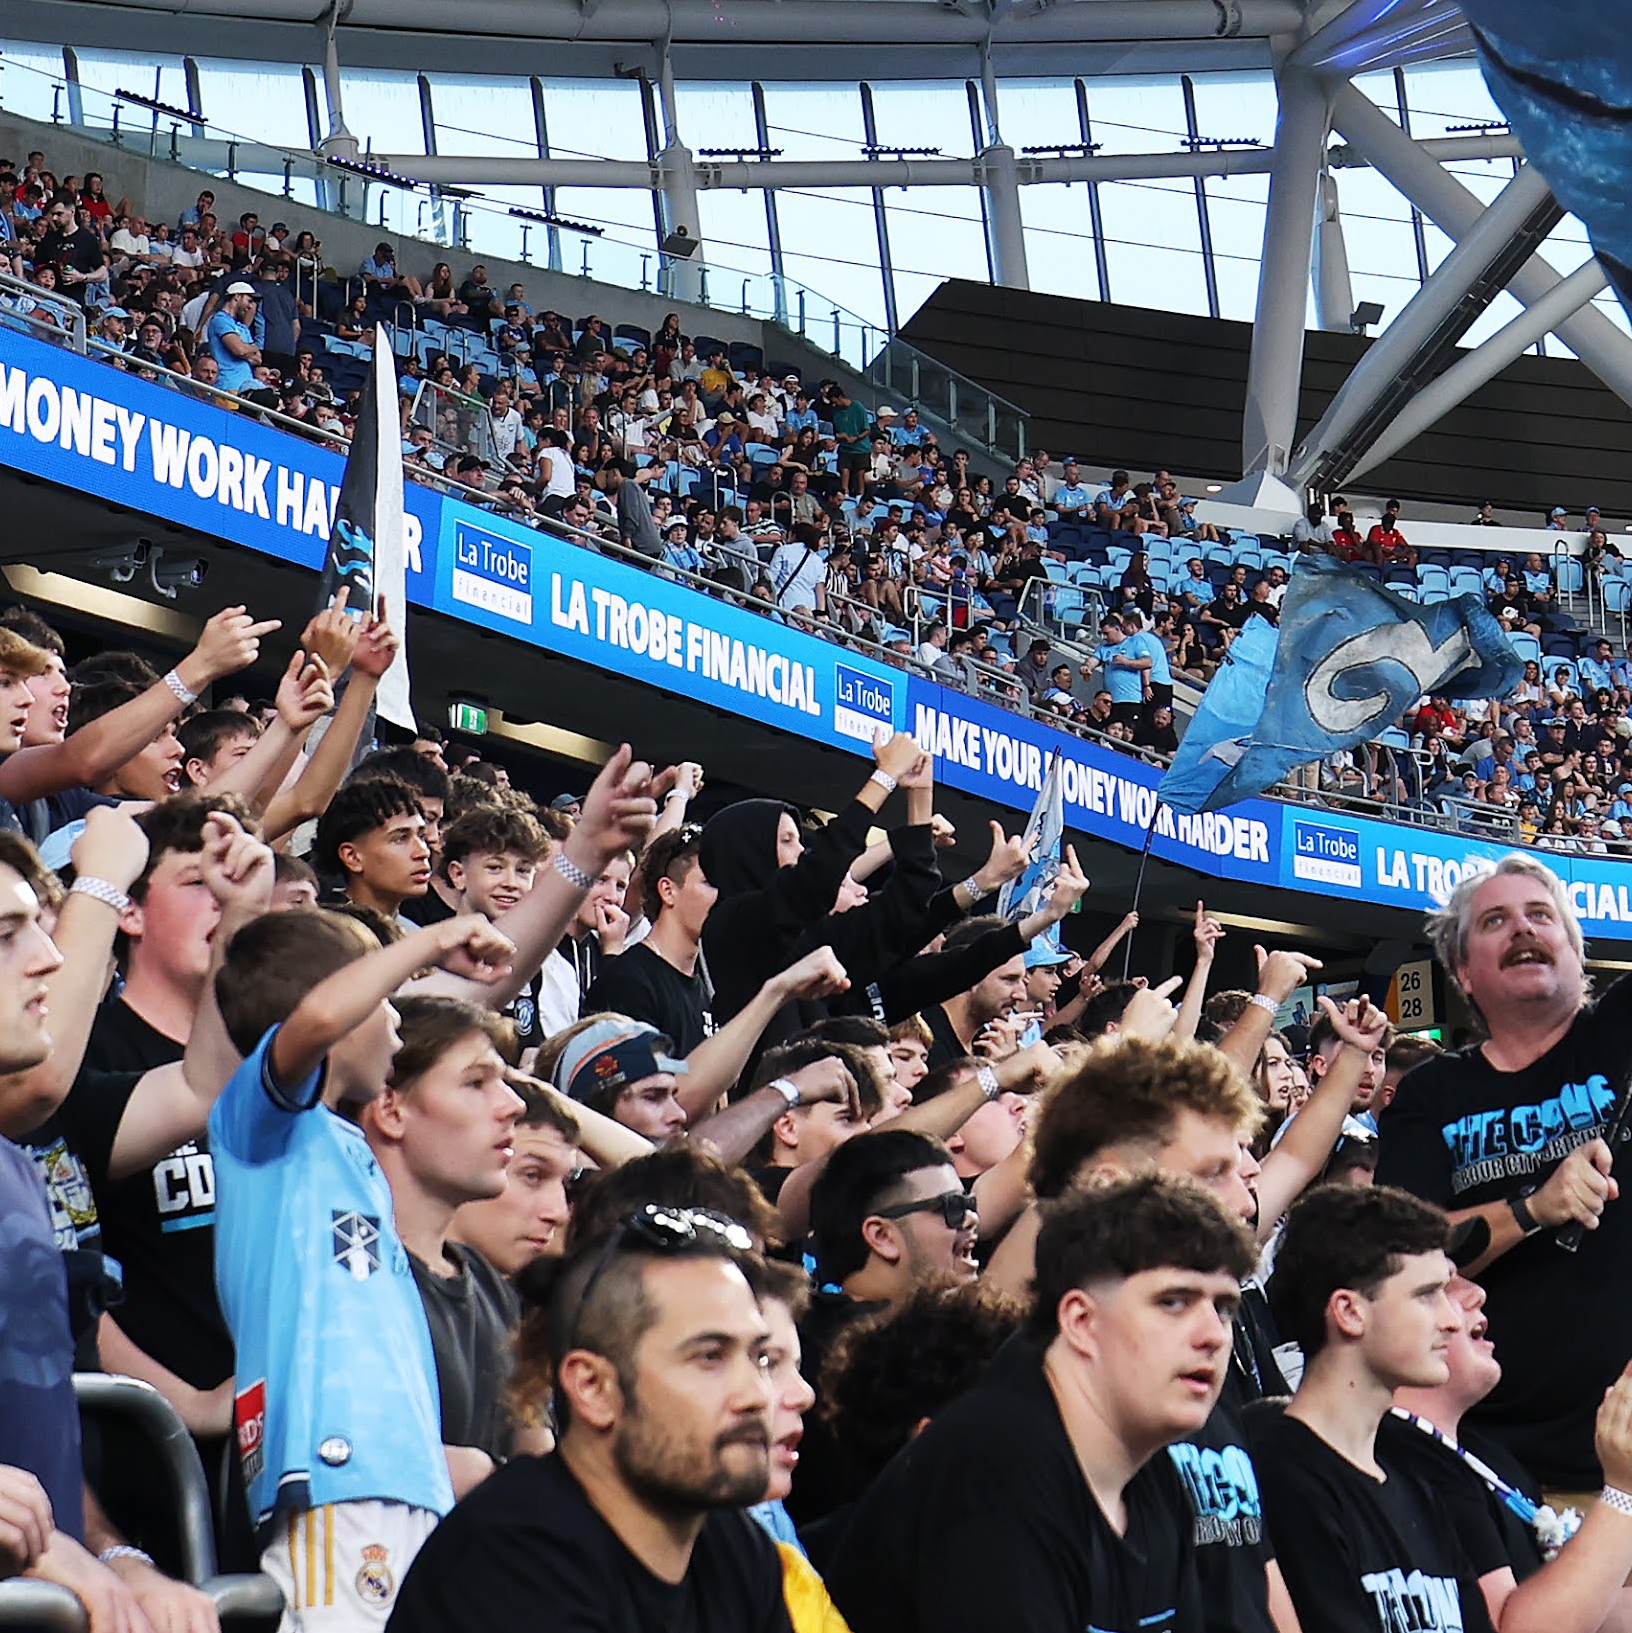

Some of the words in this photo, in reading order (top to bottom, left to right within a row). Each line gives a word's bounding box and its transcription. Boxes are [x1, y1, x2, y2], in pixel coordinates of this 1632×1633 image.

[149, 418, 271, 520] WORK
[458, 532, 478, 567] La
[480, 540, 528, 585] Trobe
[457, 576, 528, 617] financial
[550, 572, 590, 636] LA
[591, 587, 683, 668] TROBE
[686, 622, 821, 717] FINANCIAL
[838, 673, 853, 701] La
[854, 678, 891, 717] Trobe
[915, 702, 981, 771] MAKE
[982, 727, 1042, 792] YOUR
[1178, 811, 1270, 863] HARDER
[1296, 828, 1315, 851] La
[1316, 830, 1357, 860] Trobe
[1376, 846, 1411, 890] LA
[1400, 971, 1421, 992] 26
[1401, 997, 1423, 1019] 28
[1442, 1109, 1508, 1168] THE
[1510, 1073, 1616, 1154] COVE
